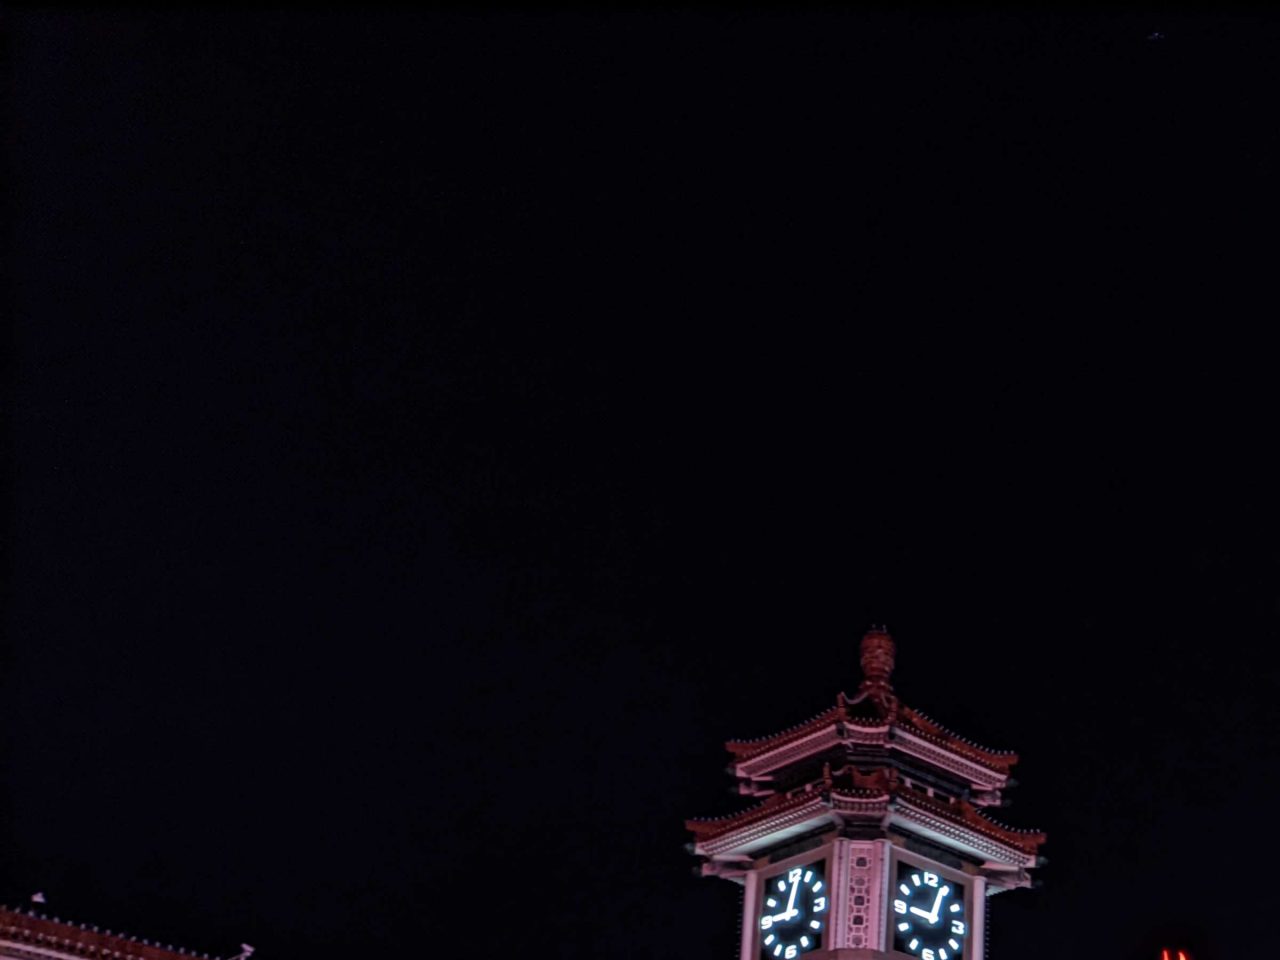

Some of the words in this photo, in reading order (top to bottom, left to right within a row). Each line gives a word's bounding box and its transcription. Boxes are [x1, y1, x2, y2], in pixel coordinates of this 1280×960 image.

[924, 872, 939, 888] 12
[813, 897, 826, 912] 3
[894, 899, 907, 915] 9
[761, 915, 773, 930] 9
[951, 920, 965, 935] 3
[784, 945, 797, 960] 6
